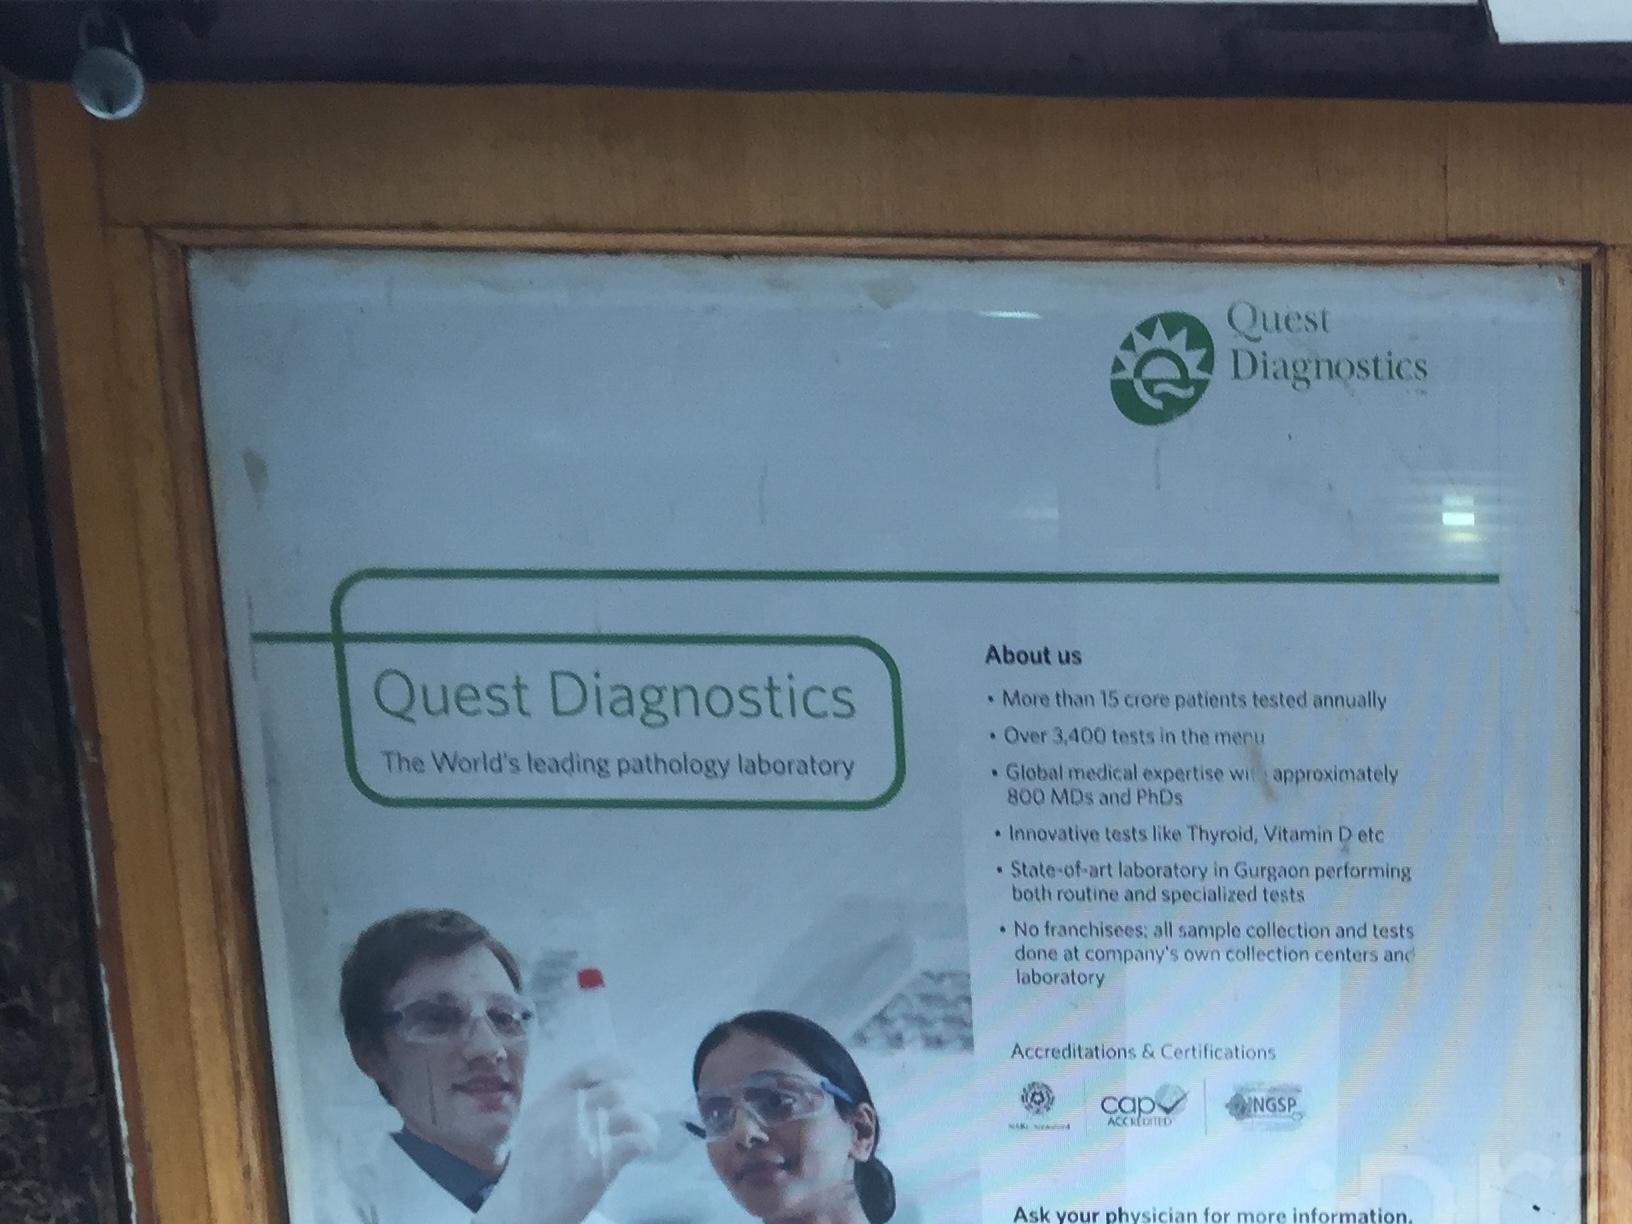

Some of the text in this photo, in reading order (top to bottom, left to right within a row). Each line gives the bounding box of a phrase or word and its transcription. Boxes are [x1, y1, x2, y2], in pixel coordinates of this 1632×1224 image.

[1226, 299, 1331, 343] Quest
[1230, 348, 1429, 391] Diagnostics
[984, 645, 1082, 667] About us
[373, 667, 858, 729] Quest Diagnostics
[1002, 690, 1387, 711] More than 15 crore patients tested annually
[1004, 727, 1047, 745] Over
[1052, 727, 1106, 747] 3,400
[1112, 728, 1154, 745] tests
[1159, 727, 1175, 745] in
[1181, 727, 1209, 745] the
[382, 749, 855, 780] The World's leading pathology laboratory
[1005, 765, 1063, 783] Global
[1068, 765, 1138, 783] medical
[1143, 765, 1224, 786] expertise
[1273, 764, 1398, 785] approximately
[1007, 788, 1183, 807] 800 MDs and PhDs
[1009, 825, 1384, 846] Innovative tests like Thyroid, Vitamin D etc
[1010, 861, 1412, 882] State-of-art laboratory in Gurgaon performing
[1012, 885, 1305, 905] both routine and specialized tests
[1014, 922, 1039, 938] No
[1153, 921, 1173, 939] all
[1178, 922, 1241, 941] sample
[1246, 921, 1331, 939] collection
[1335, 921, 1367, 939] and
[1372, 923, 1415, 940] tests
[1014, 945, 1058, 962] done
[1063, 946, 1080, 962] at
[1085, 945, 1179, 965] company's
[1184, 949, 1220, 963] own
[1225, 945, 1309, 963] collection
[1314, 947, 1378, 963] centers
[1016, 968, 1104, 989] laboratory
[1010, 1043, 1277, 1061] Accreditations & Certifications
[1100, 1094, 1156, 1117] cap
[1107, 1117, 1172, 1128] ACCREDITED
[1013, 1207, 1051, 1224] Ask
[1204, 1207, 1230, 1224] for
[1237, 1210, 1287, 1224] more
[1292, 1207, 1414, 1224] information.
